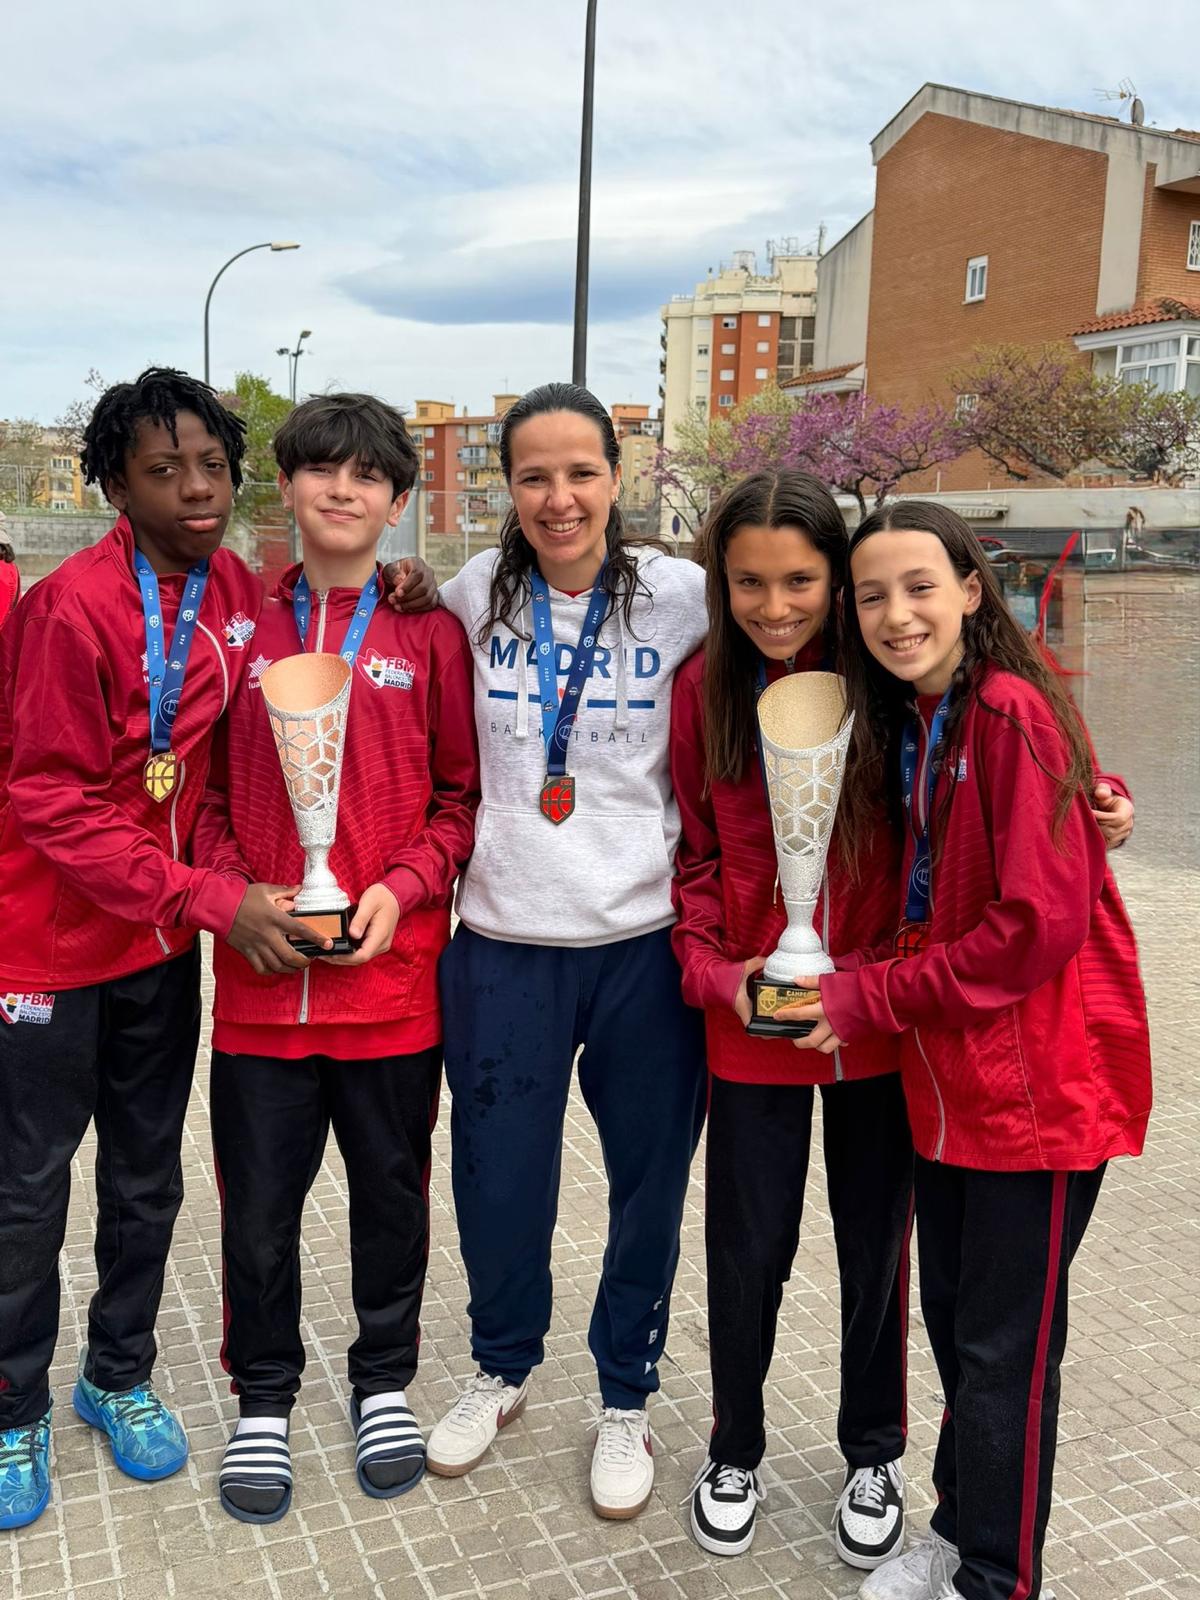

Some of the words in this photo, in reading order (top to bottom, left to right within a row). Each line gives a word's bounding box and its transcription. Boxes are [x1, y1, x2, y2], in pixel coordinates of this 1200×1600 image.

[386, 657, 416, 674] FBM
[384, 679, 413, 690] MADRID
[490, 722, 648, 744] BAKTBALL
[22, 993, 54, 1007] FBM
[19, 1014, 51, 1024] MADRID
